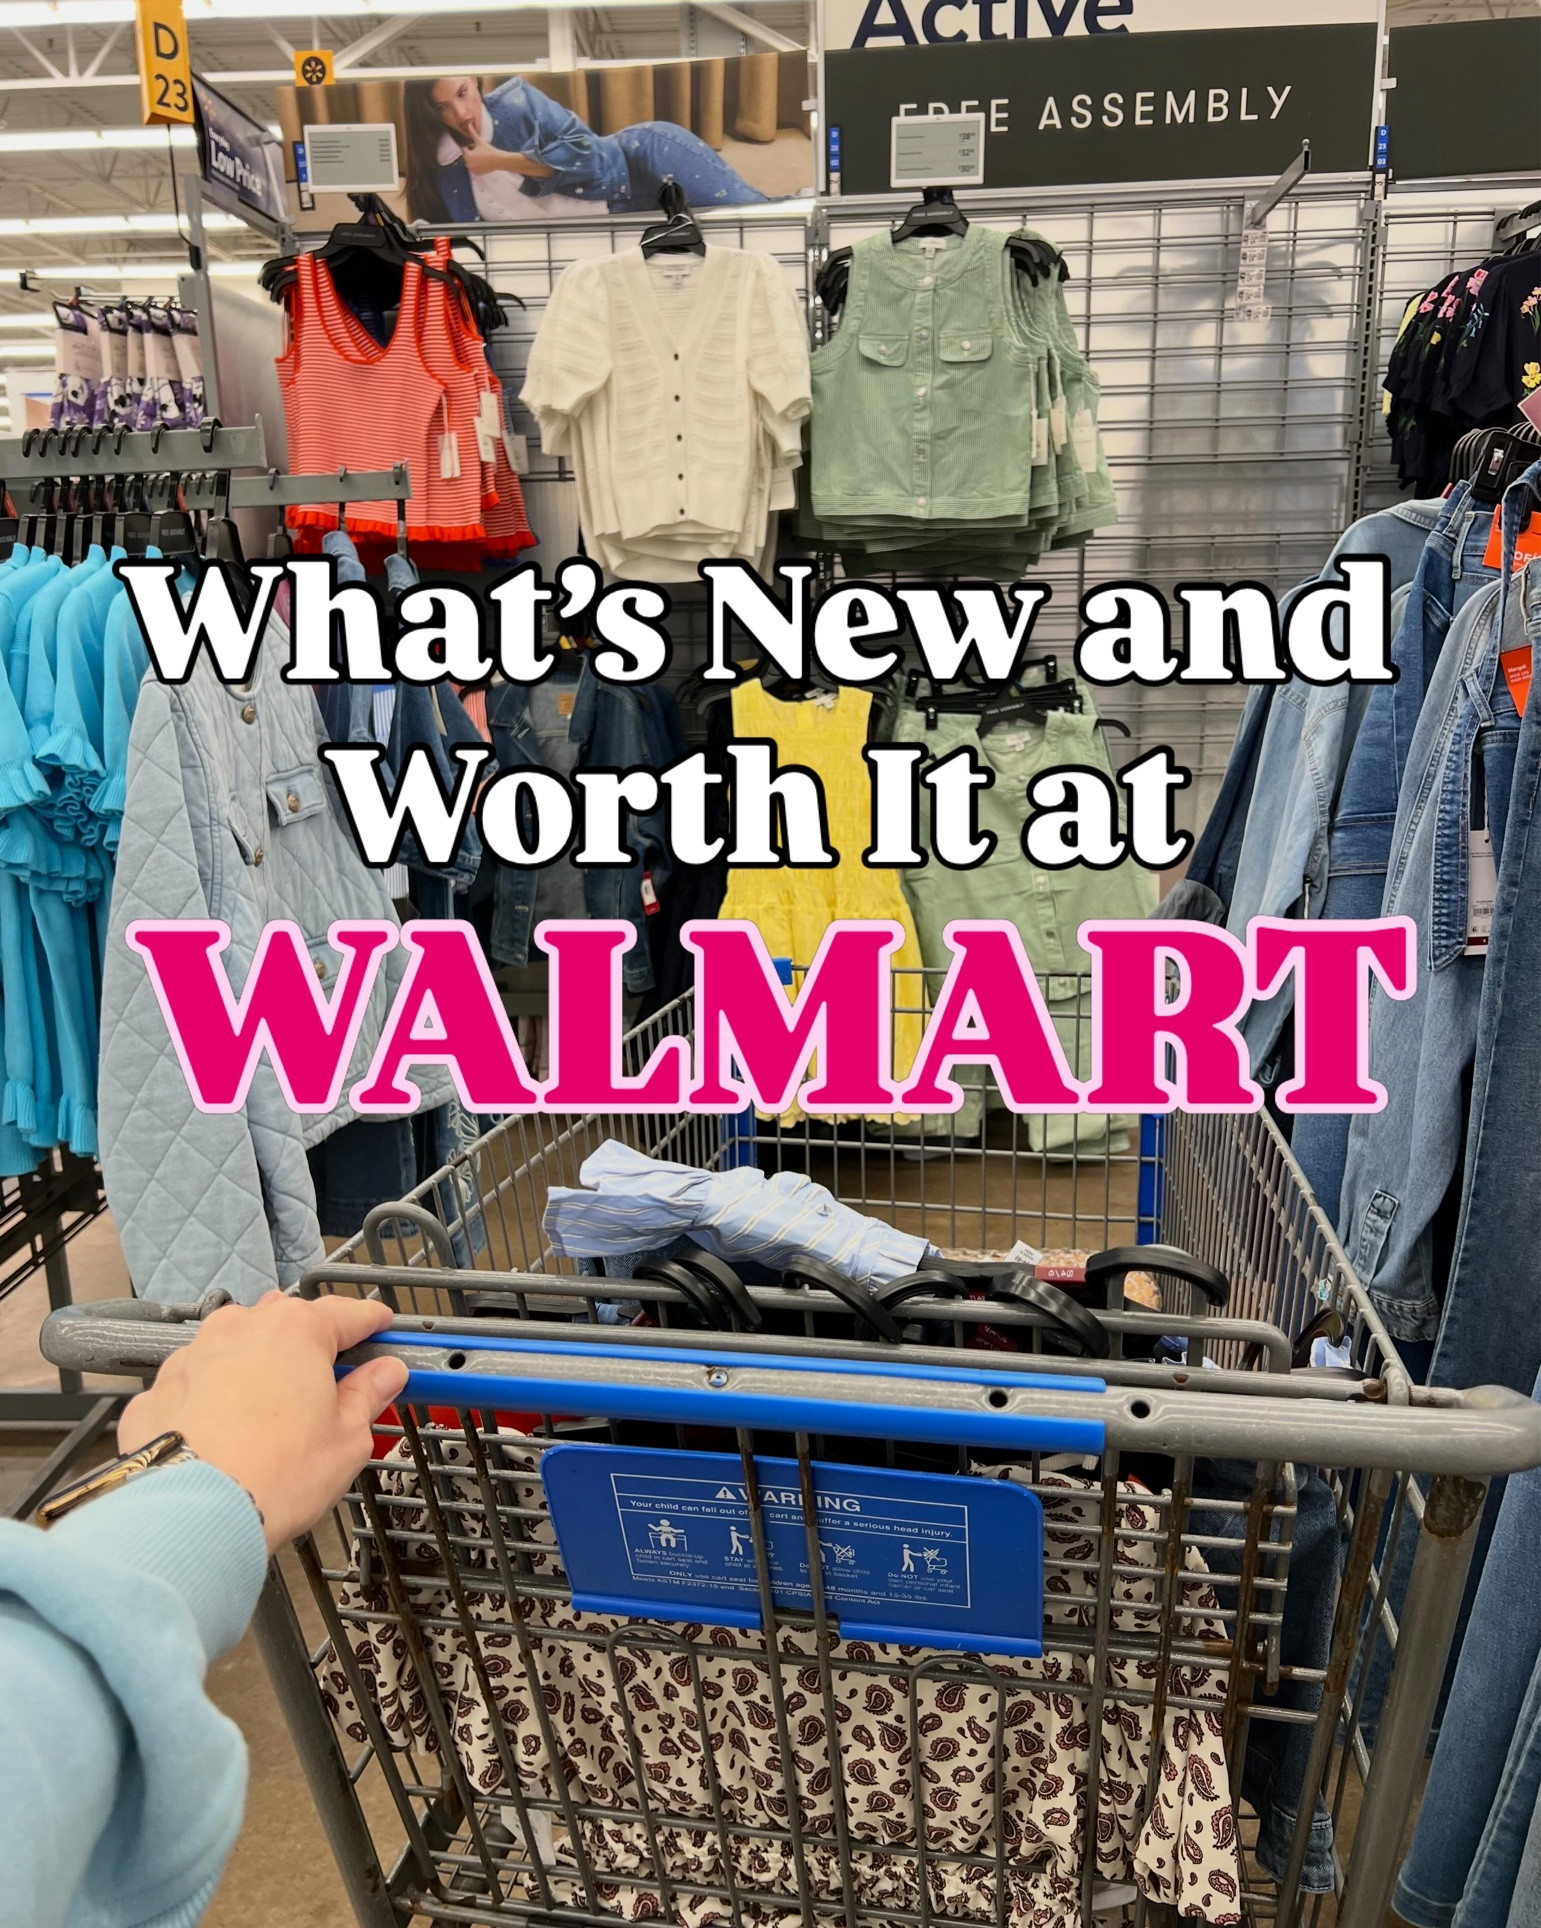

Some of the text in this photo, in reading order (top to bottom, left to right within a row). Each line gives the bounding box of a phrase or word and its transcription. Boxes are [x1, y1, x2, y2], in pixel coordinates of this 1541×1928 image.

[153, 21, 179, 61] D
[155, 73, 189, 112] 23
[1037, 85, 1292, 130] ASSEMBLY
[1377, 142, 1387, 150] 23
[629, 1500, 653, 1508] Your
[654, 1502, 679, 1510] child
[818, 1517, 842, 1525] uffer
[853, 1522, 891, 1531] serious
[893, 1524, 918, 1534] head
[921, 1528, 953, 1538] injury.
[634, 1547, 667, 1556] ALWAYS
[632, 1575, 655, 1583] Meets
[834, 1595, 866, 1603] Content
[838, 1587, 868, 1595] months
[905, 1579, 938, 1587] personal
